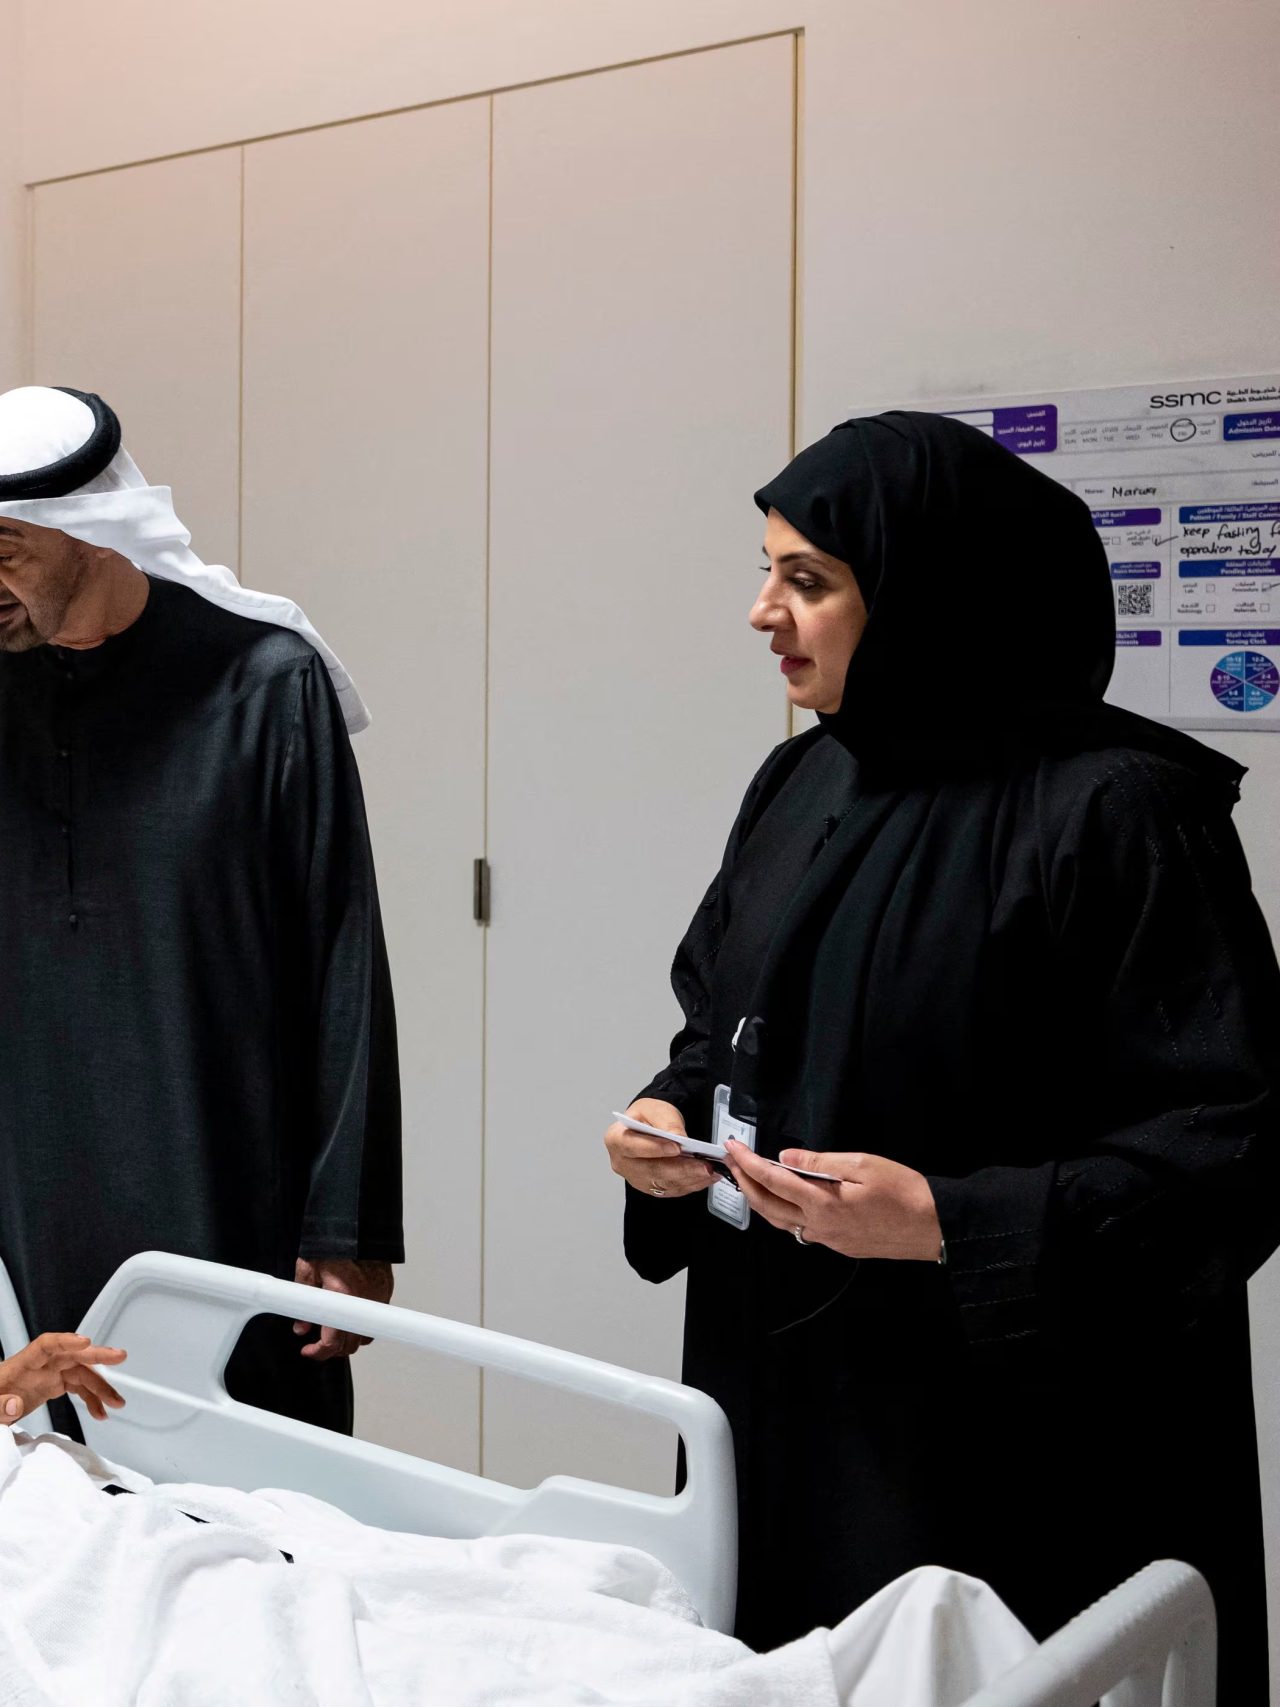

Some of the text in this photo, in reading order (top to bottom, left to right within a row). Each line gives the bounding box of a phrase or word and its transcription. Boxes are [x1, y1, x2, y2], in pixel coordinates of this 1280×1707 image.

[1149, 391, 1222, 409] ssmc
[1228, 427, 1263, 435] Admission
[1183, 526, 1210, 539] keep
[1217, 523, 1261, 549] fasting
